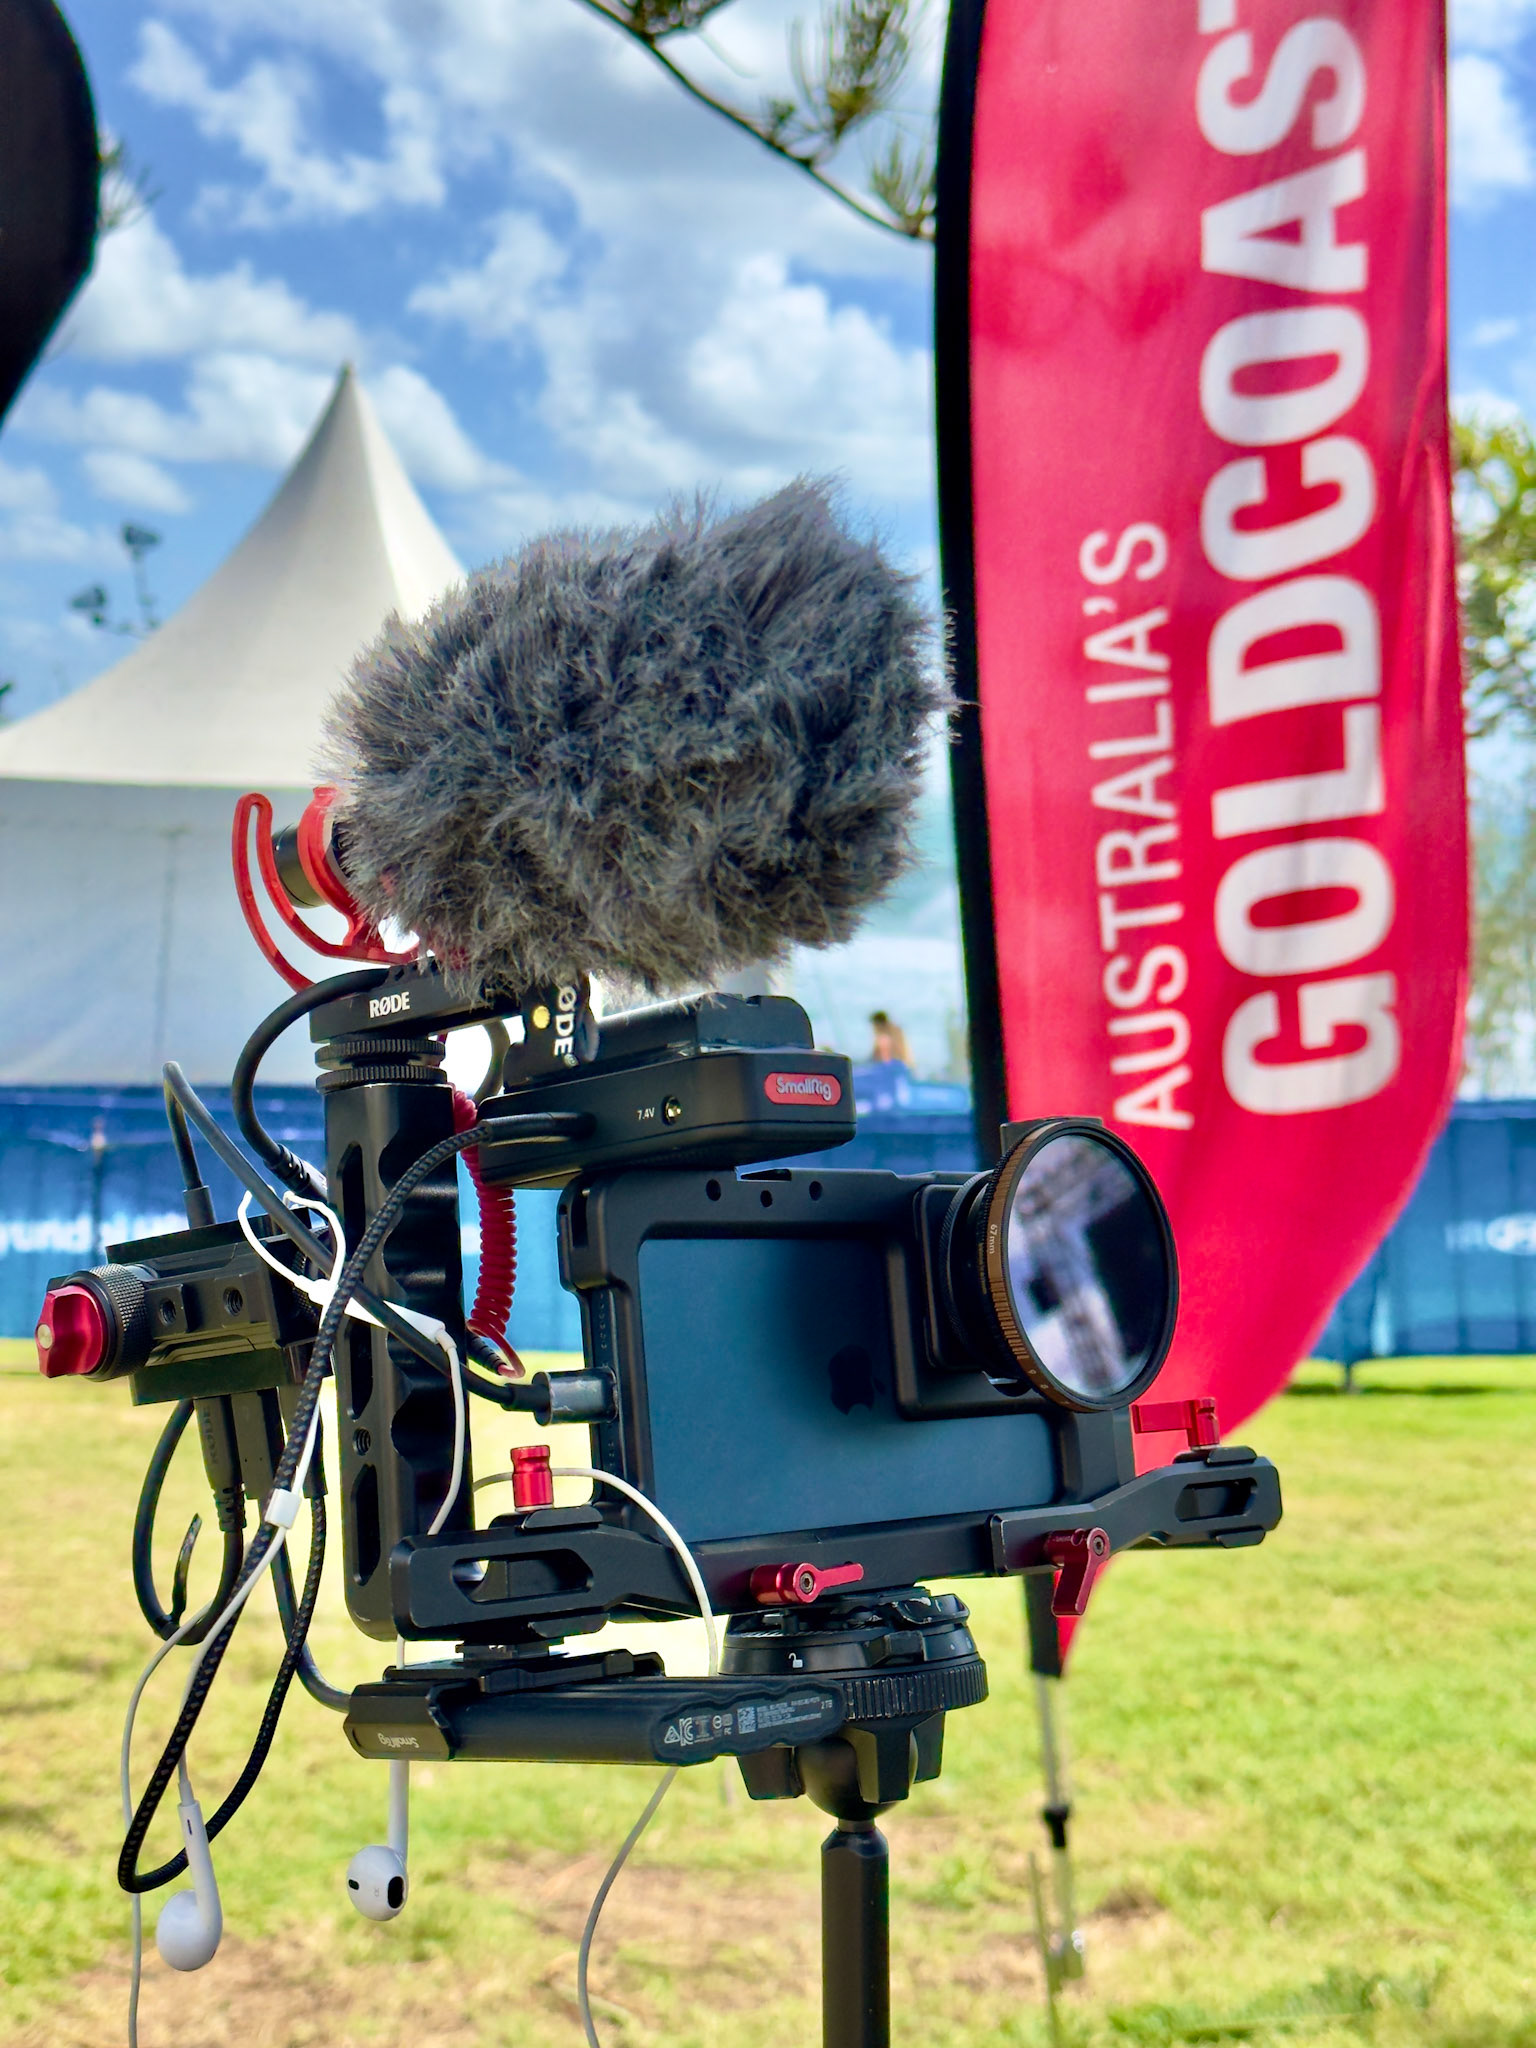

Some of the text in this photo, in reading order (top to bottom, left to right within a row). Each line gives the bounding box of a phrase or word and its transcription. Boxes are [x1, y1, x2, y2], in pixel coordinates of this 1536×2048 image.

[1195, 0, 1400, 1117] GOLDCOAS
[1079, 521, 1195, 1130] AUSTRALIA'S
[369, 991, 411, 1019] RØDE
[553, 985, 578, 1057] ØDE
[636, 1106, 655, 1121] 7.4V
[776, 1076, 832, 1102] SmallRig
